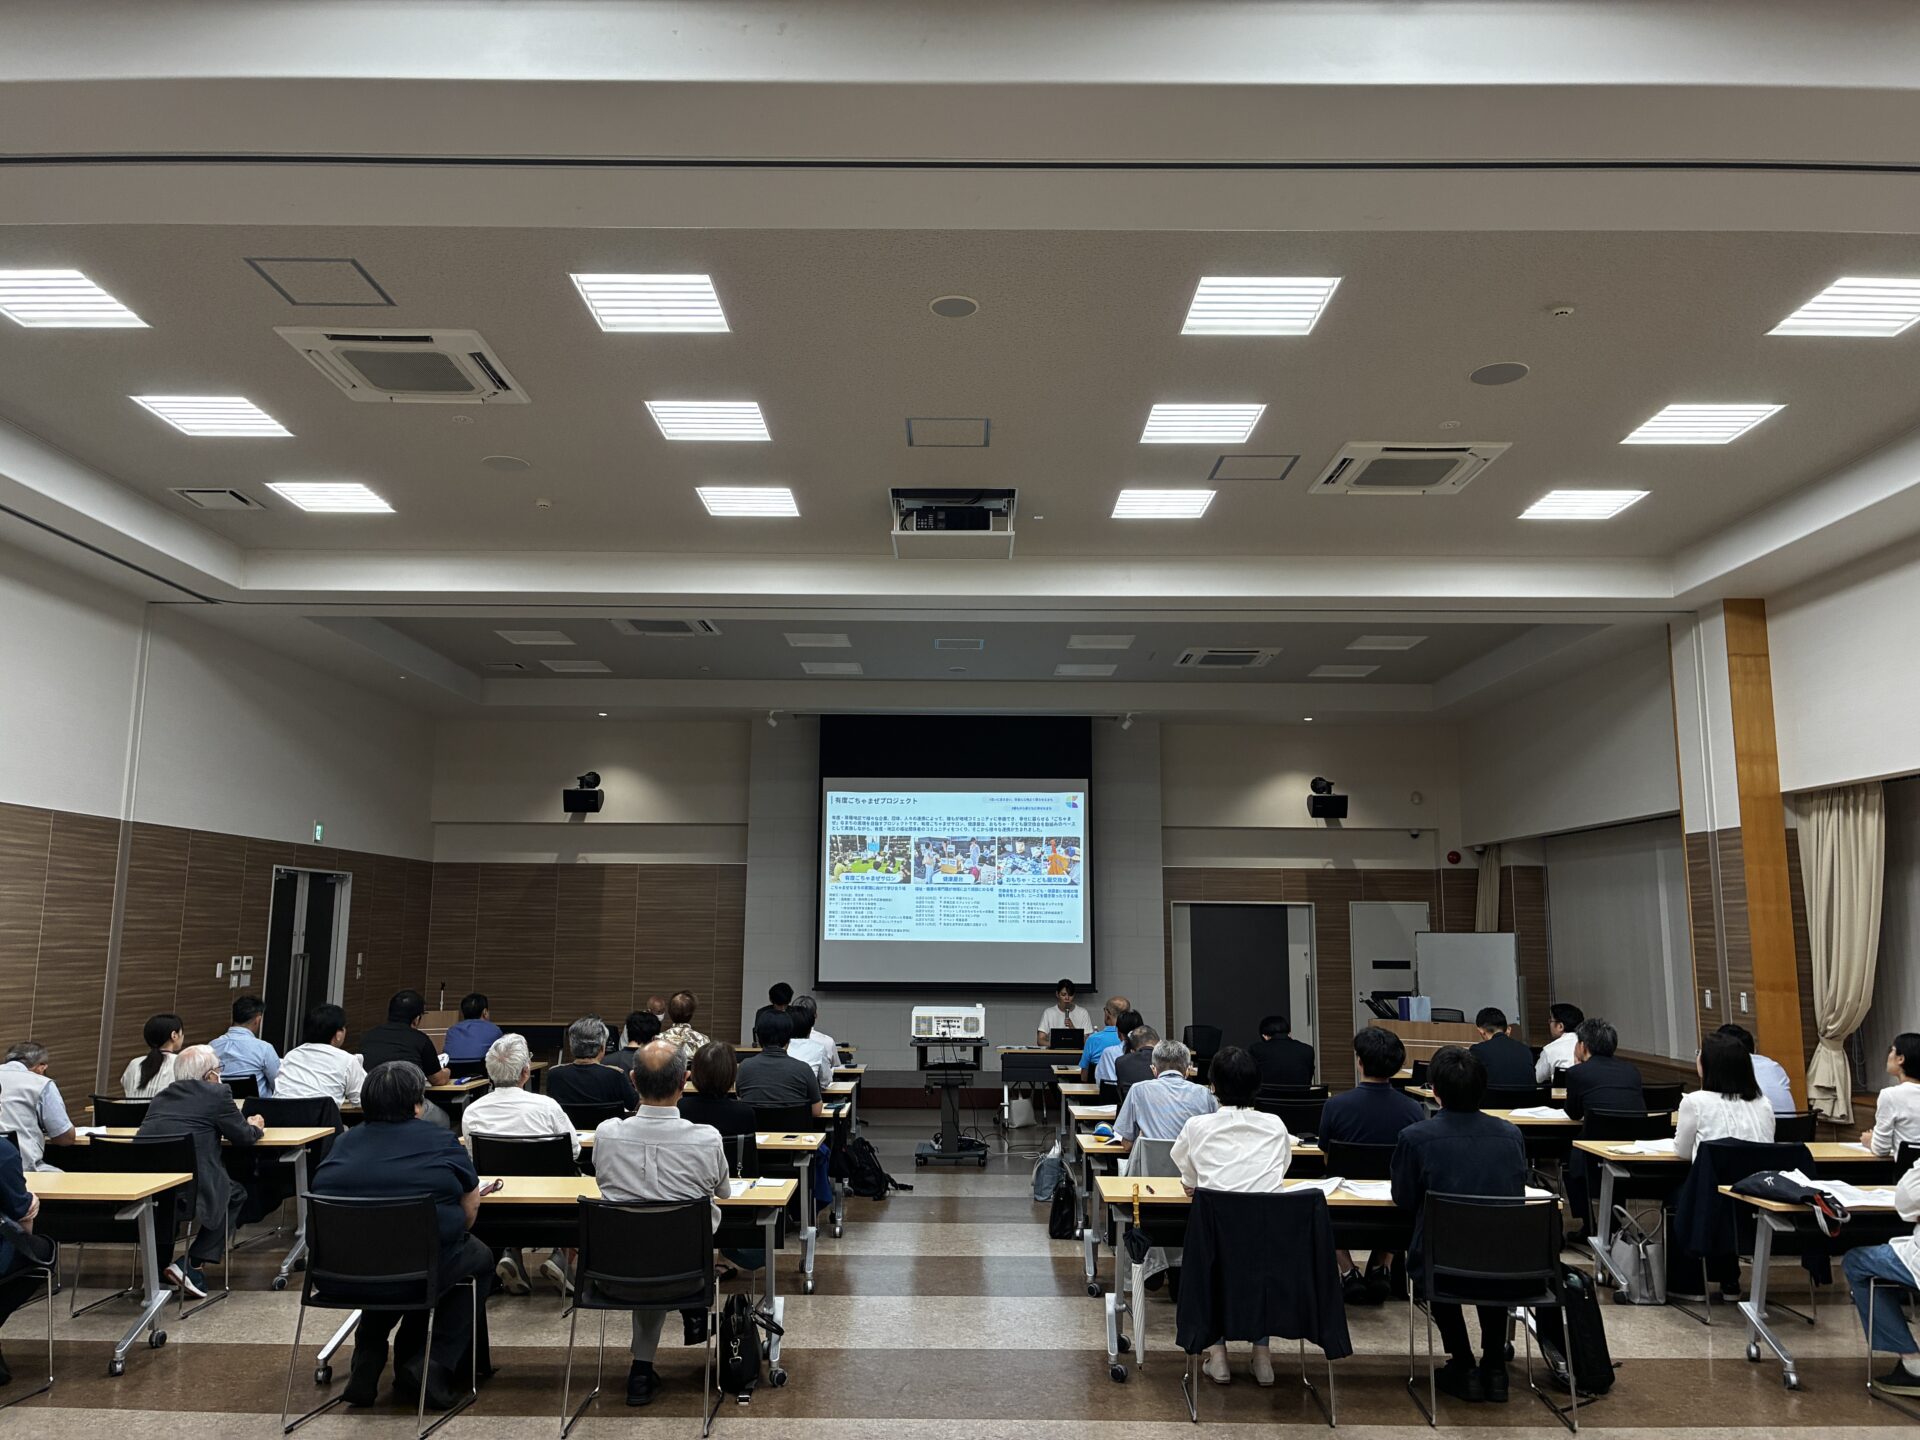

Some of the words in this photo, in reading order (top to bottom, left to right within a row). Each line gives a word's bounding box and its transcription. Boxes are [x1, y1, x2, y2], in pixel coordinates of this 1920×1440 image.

[835, 797, 918, 805] 有度ごちゃまぜプロジェクト
